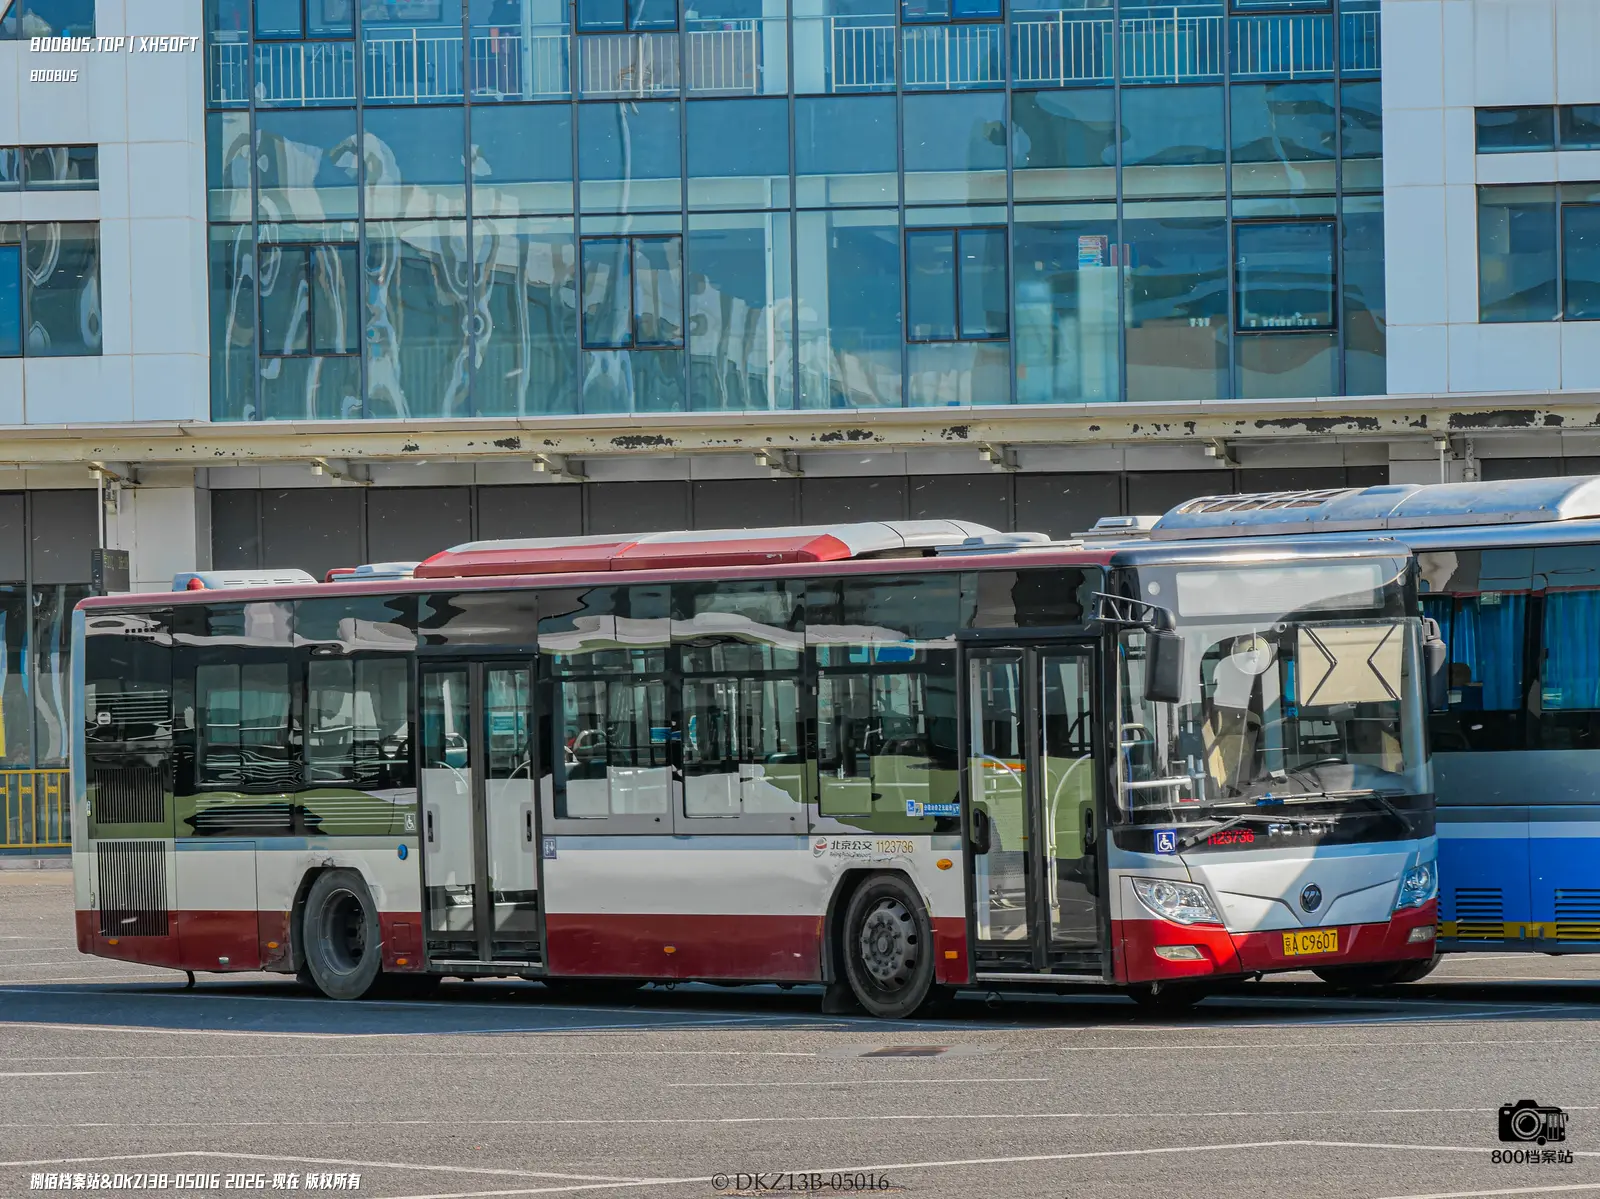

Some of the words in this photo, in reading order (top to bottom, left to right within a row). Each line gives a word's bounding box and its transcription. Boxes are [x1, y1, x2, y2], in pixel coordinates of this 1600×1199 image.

[830, 840, 873, 851] 北京公交
[876, 840, 914, 854] 1123736
